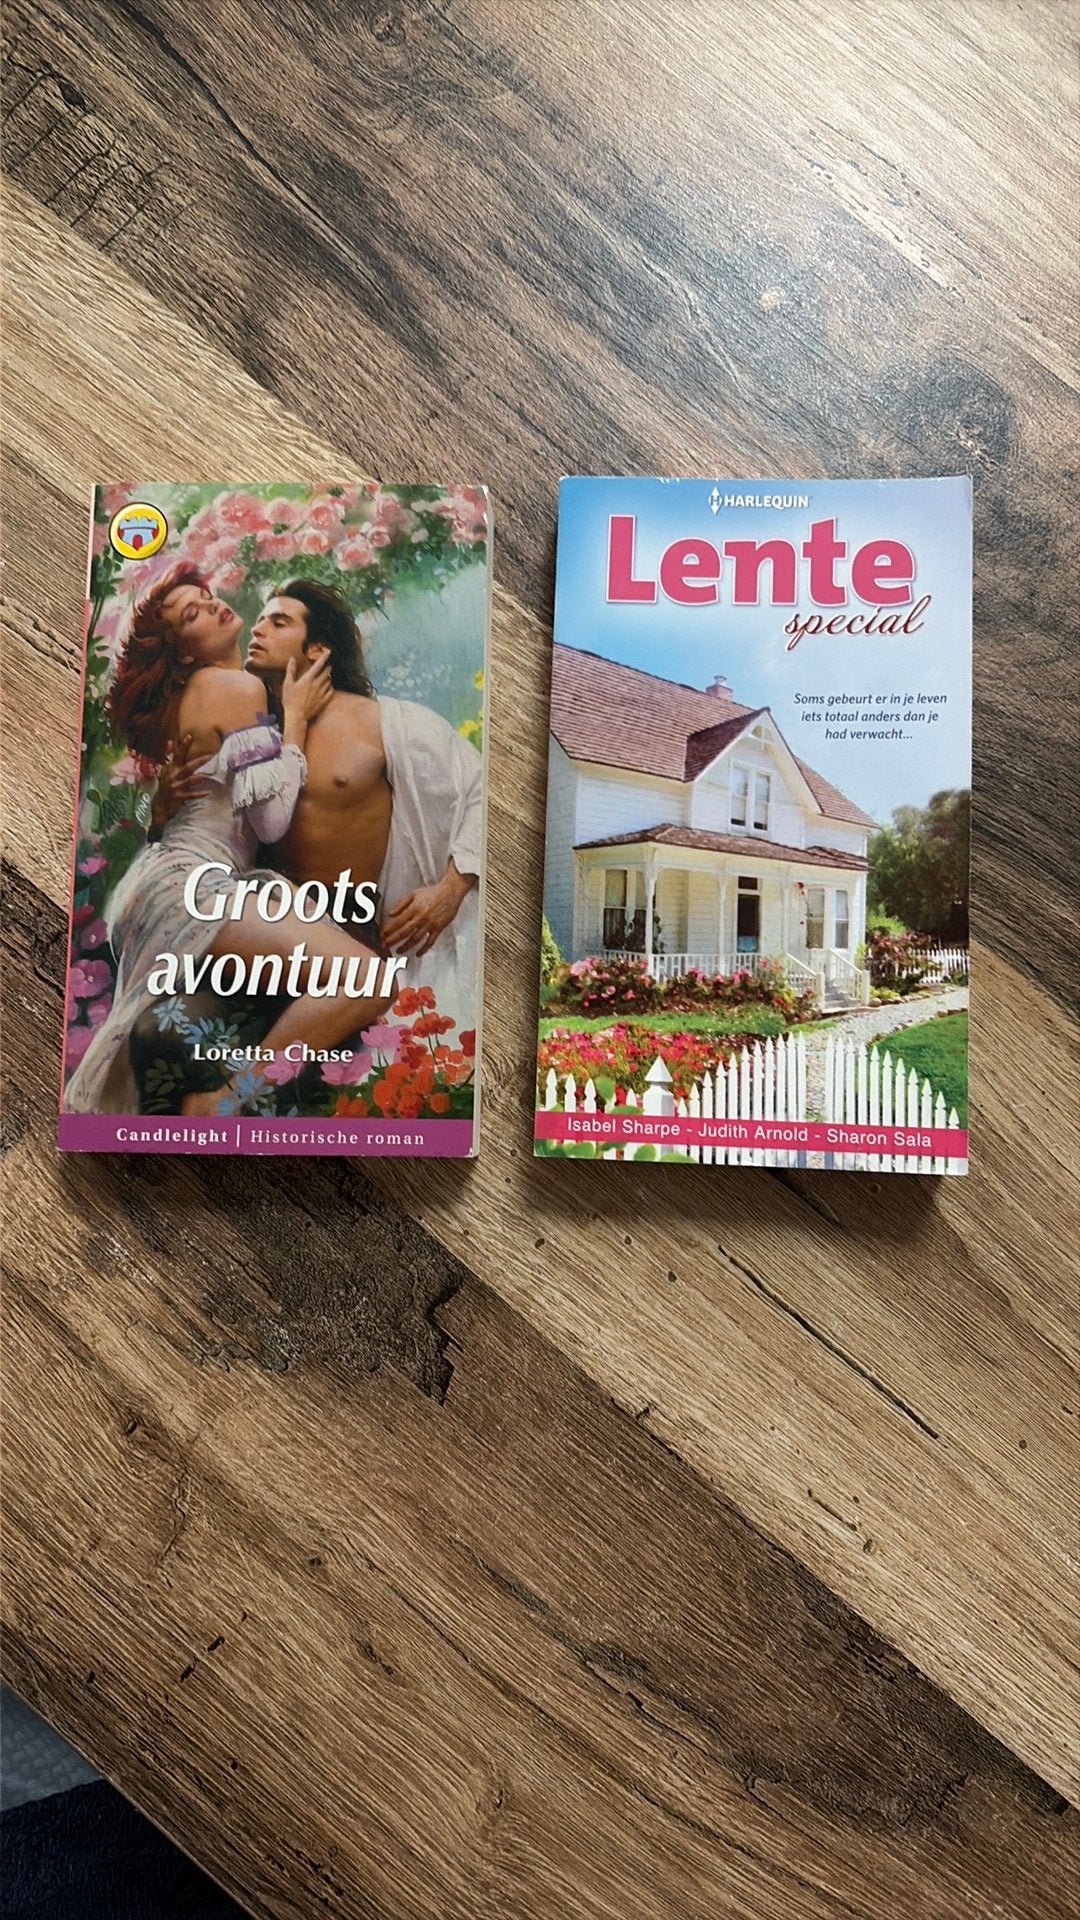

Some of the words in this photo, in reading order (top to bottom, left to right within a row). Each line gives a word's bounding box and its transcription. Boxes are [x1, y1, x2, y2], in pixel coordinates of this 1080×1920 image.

[724, 494, 809, 510] HARLEQUIN
[606, 514, 915, 607] Lente
[783, 593, 932, 651] special
[794, 693, 825, 705] Soms
[827, 693, 873, 706] gebeurt
[875, 696, 887, 705] er
[890, 694, 901, 704] in
[902, 694, 914, 707] je
[916, 693, 948, 704] leven
[801, 711, 822, 722] iets
[824, 711, 859, 722] totaal
[861, 711, 901, 722] anders
[903, 711, 926, 722] dan
[926, 711, 939, 724] je
[825, 728, 848, 740] had
[850, 728, 913, 740] verwacht...
[183, 861, 379, 924] Groots
[146, 941, 408, 999] avontuur
[193, 1043, 275, 1062] Loretta
[284, 1043, 354, 1063] Chase
[116, 1127, 228, 1145] Candlelight
[250, 1129, 358, 1145] Historische
[366, 1132, 425, 1145] roman
[567, 1117, 616, 1134] Isabel
[621, 1118, 681, 1137] Sharpe
[697, 1122, 748, 1139] Judith
[754, 1125, 808, 1142] Arnold
[826, 1127, 887, 1145] Sharon
[894, 1131, 932, 1148] Sala
